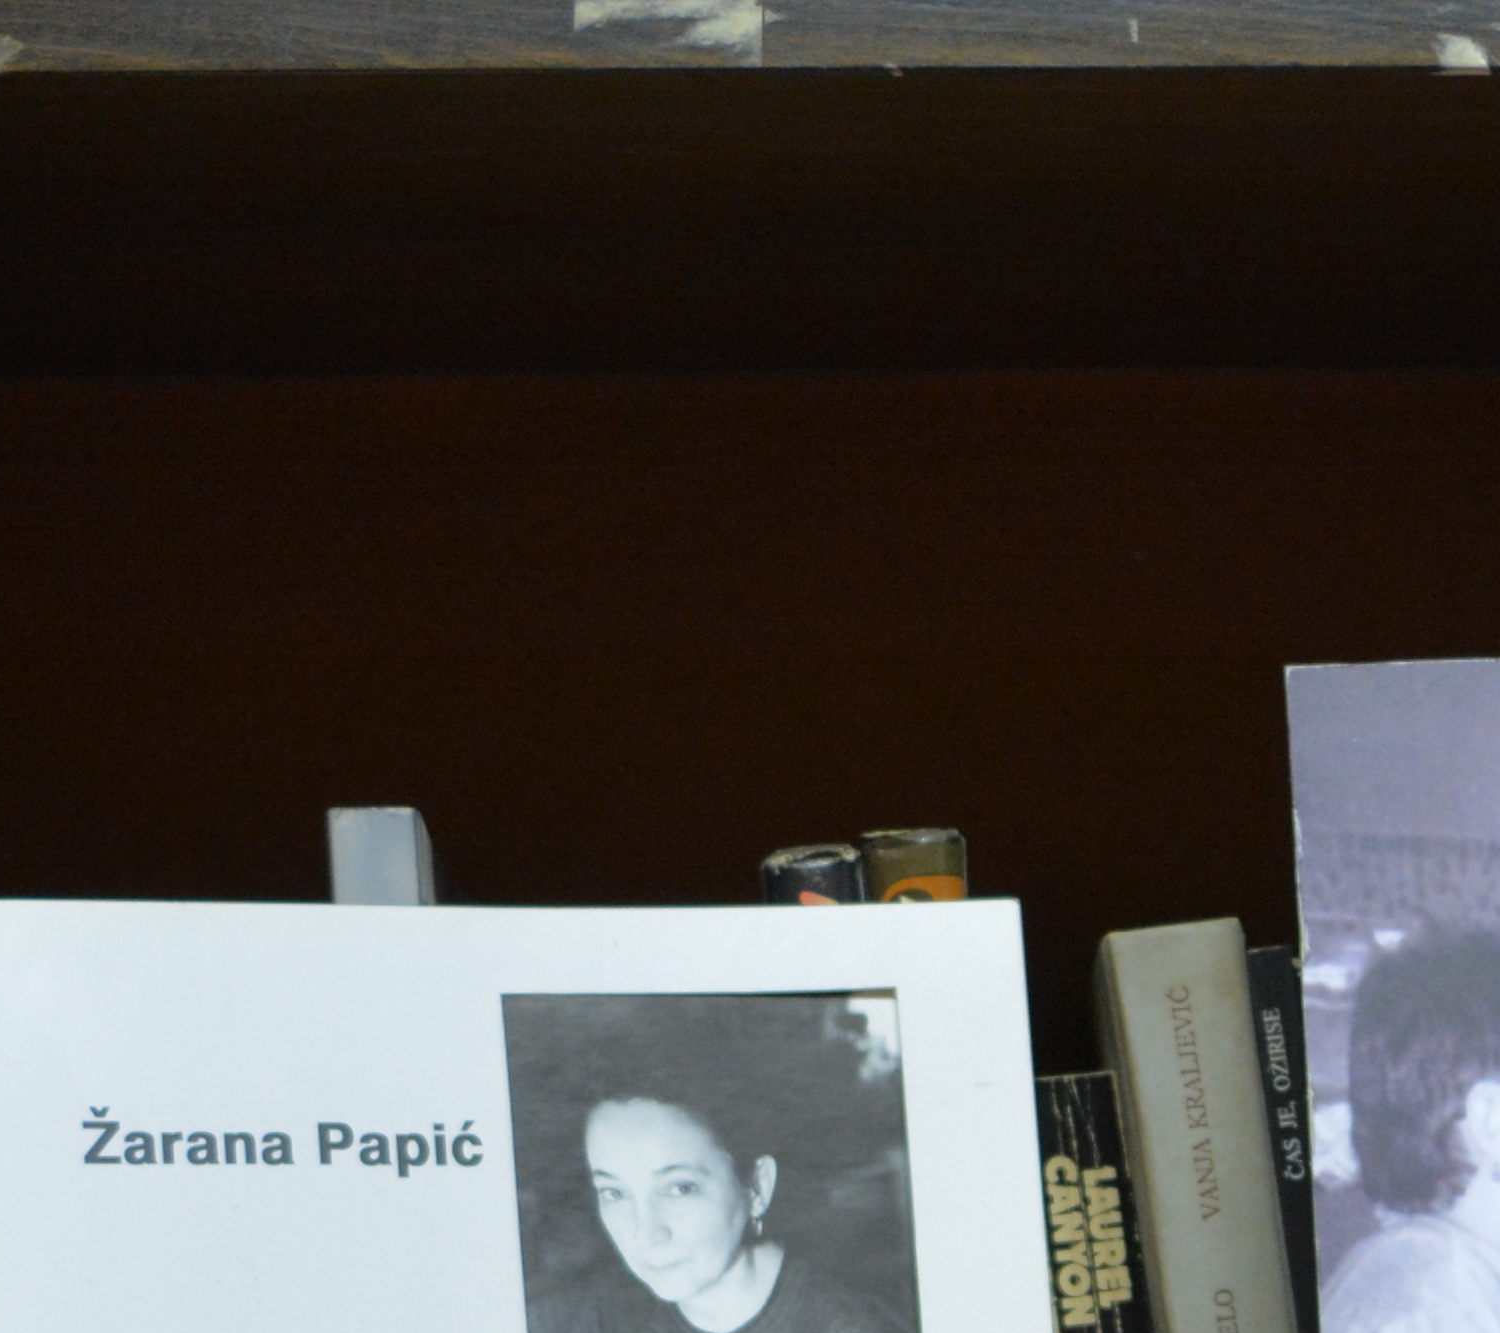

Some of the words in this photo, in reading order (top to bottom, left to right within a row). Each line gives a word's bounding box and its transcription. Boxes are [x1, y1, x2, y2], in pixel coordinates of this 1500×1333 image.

[1164, 983, 1211, 1133] KRALJEVIĆ
[80, 1104, 296, 1168] Žarana
[316, 1119, 486, 1179] Papić
[1191, 1138, 1223, 1221] VANJA
[1044, 1154, 1097, 1327] CANYON
[1082, 1163, 1132, 1308] LAUREL
